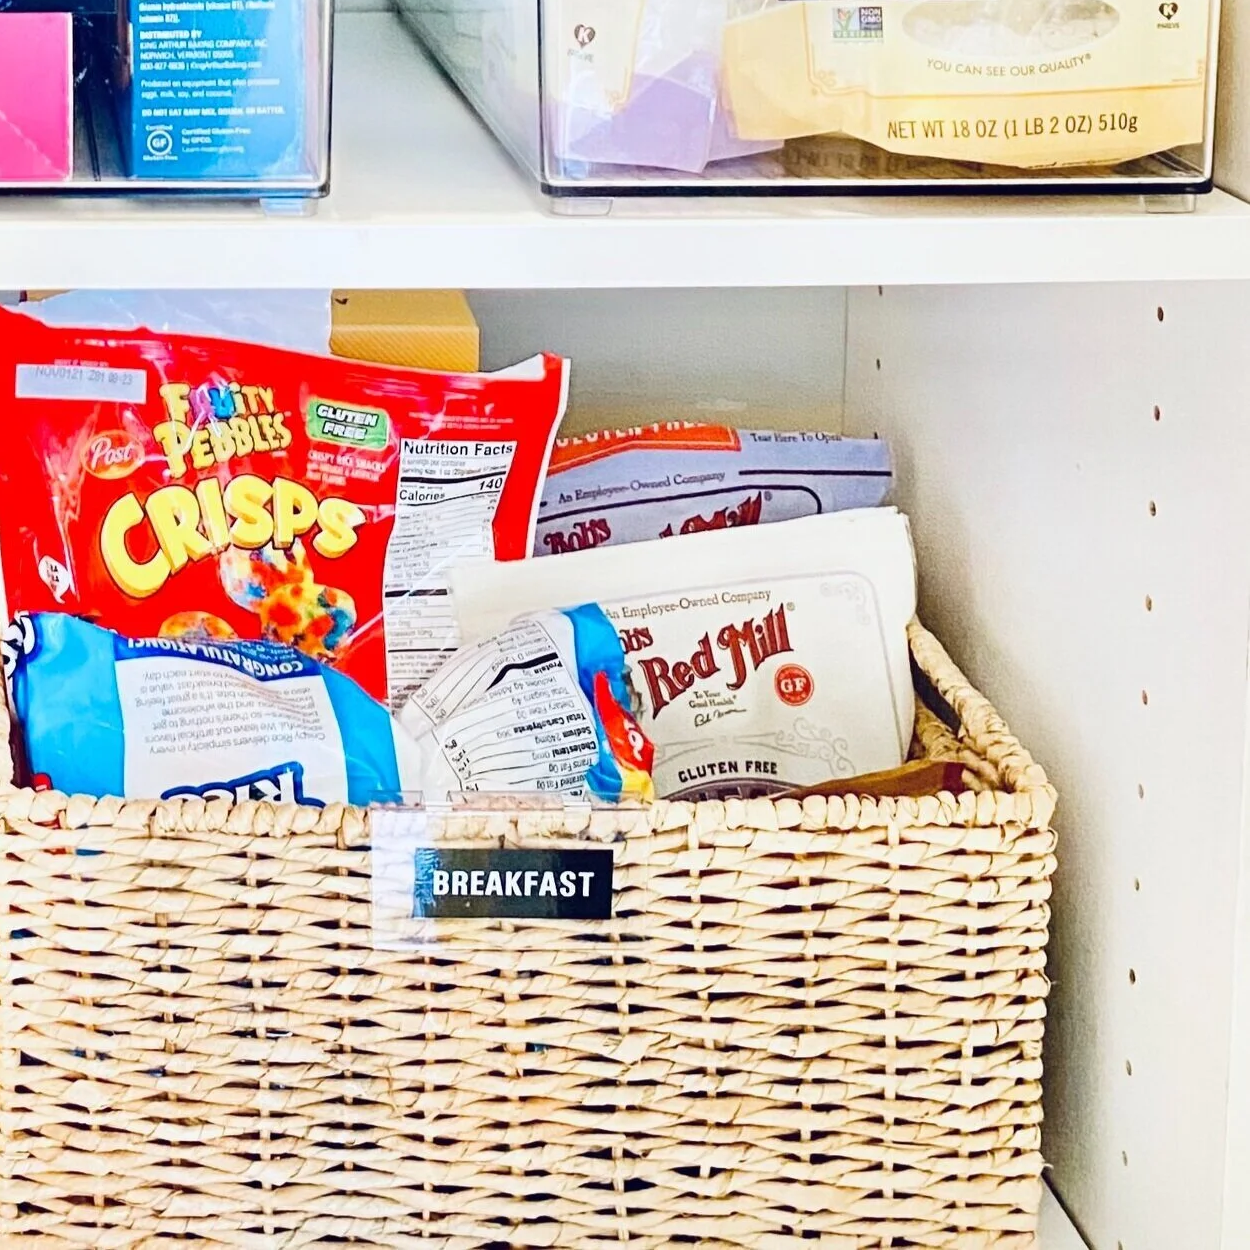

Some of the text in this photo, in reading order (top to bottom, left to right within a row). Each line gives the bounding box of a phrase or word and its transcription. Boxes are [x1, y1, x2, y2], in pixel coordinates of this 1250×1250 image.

[926, 58, 952, 72] YOU
[955, 63, 982, 75] CAN
[986, 66, 1006, 76] SEE
[1009, 63, 1036, 76] OUR
[887, 113, 1138, 141] NET WT 18 OZ (1 LB 2 OZ) 510g
[317, 404, 379, 427] GLUTEN
[322, 420, 367, 440] FREE
[751, 433, 771, 443] Tear
[775, 433, 797, 442] Here
[800, 432, 814, 442] To
[90, 436, 133, 469] Post
[153, 414, 293, 479] PEBBLES
[404, 440, 513, 456] Nutrition Facts
[479, 477, 503, 490] 140
[558, 471, 726, 504] An Employee-Owned Company
[399, 490, 445, 502] Calories
[100, 473, 367, 598] CRISPS
[622, 589, 771, 619] Employee-Owned Company
[534, 661, 563, 675] Protein
[638, 632, 720, 720] Red
[717, 602, 795, 691] Mill
[780, 677, 807, 694] GF
[566, 712, 585, 724] Total
[272, 734, 293, 745] Rice
[563, 726, 591, 738] Sodium
[150, 742, 176, 754] every
[187, 738, 231, 752] simplicity
[233, 735, 270, 748] delivers
[552, 741, 596, 758] Cholesterol
[678, 760, 778, 783] GLUTEN FREE
[433, 870, 595, 898] BREAKFAST
